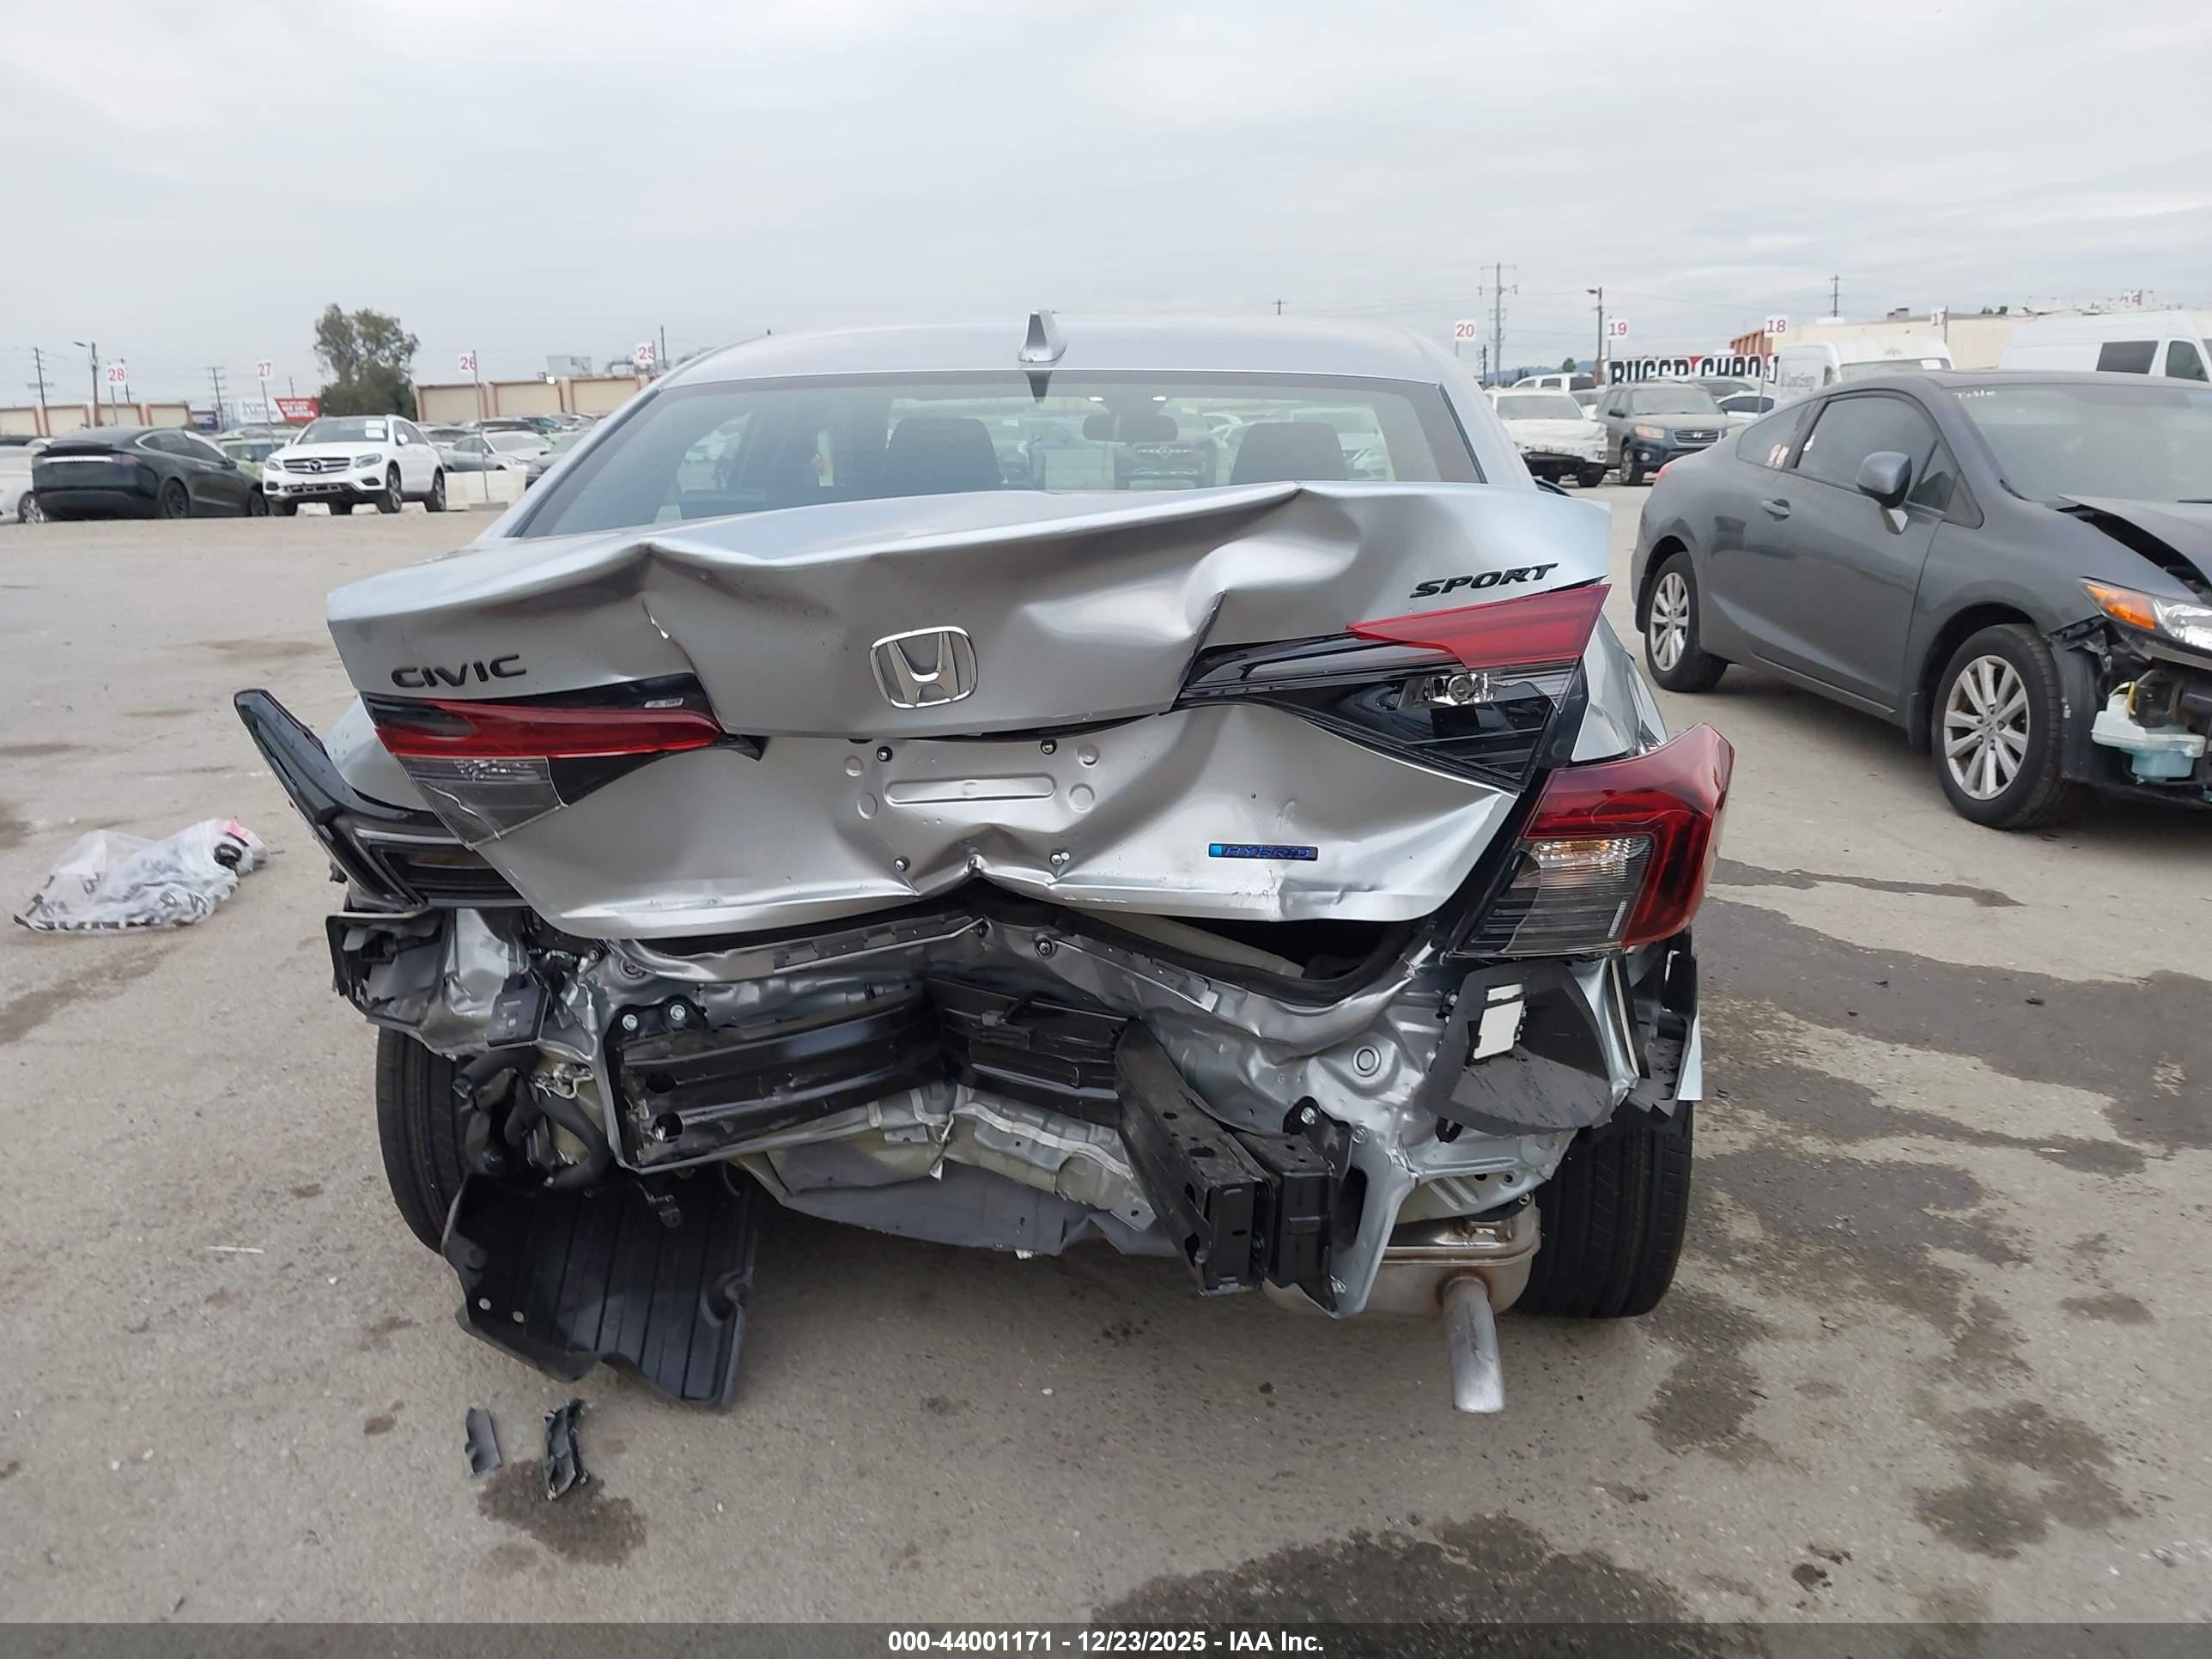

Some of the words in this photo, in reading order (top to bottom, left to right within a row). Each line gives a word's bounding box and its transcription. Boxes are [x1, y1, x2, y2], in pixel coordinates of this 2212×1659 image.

[1456, 324, 1474, 337] 20
[1609, 322, 1627, 336] 19
[1766, 319, 1786, 333] 18
[109, 368, 125, 381] 28
[258, 362, 271, 377] 27
[1409, 562, 1559, 599] SPORT
[391, 653, 527, 688] CIVIC
